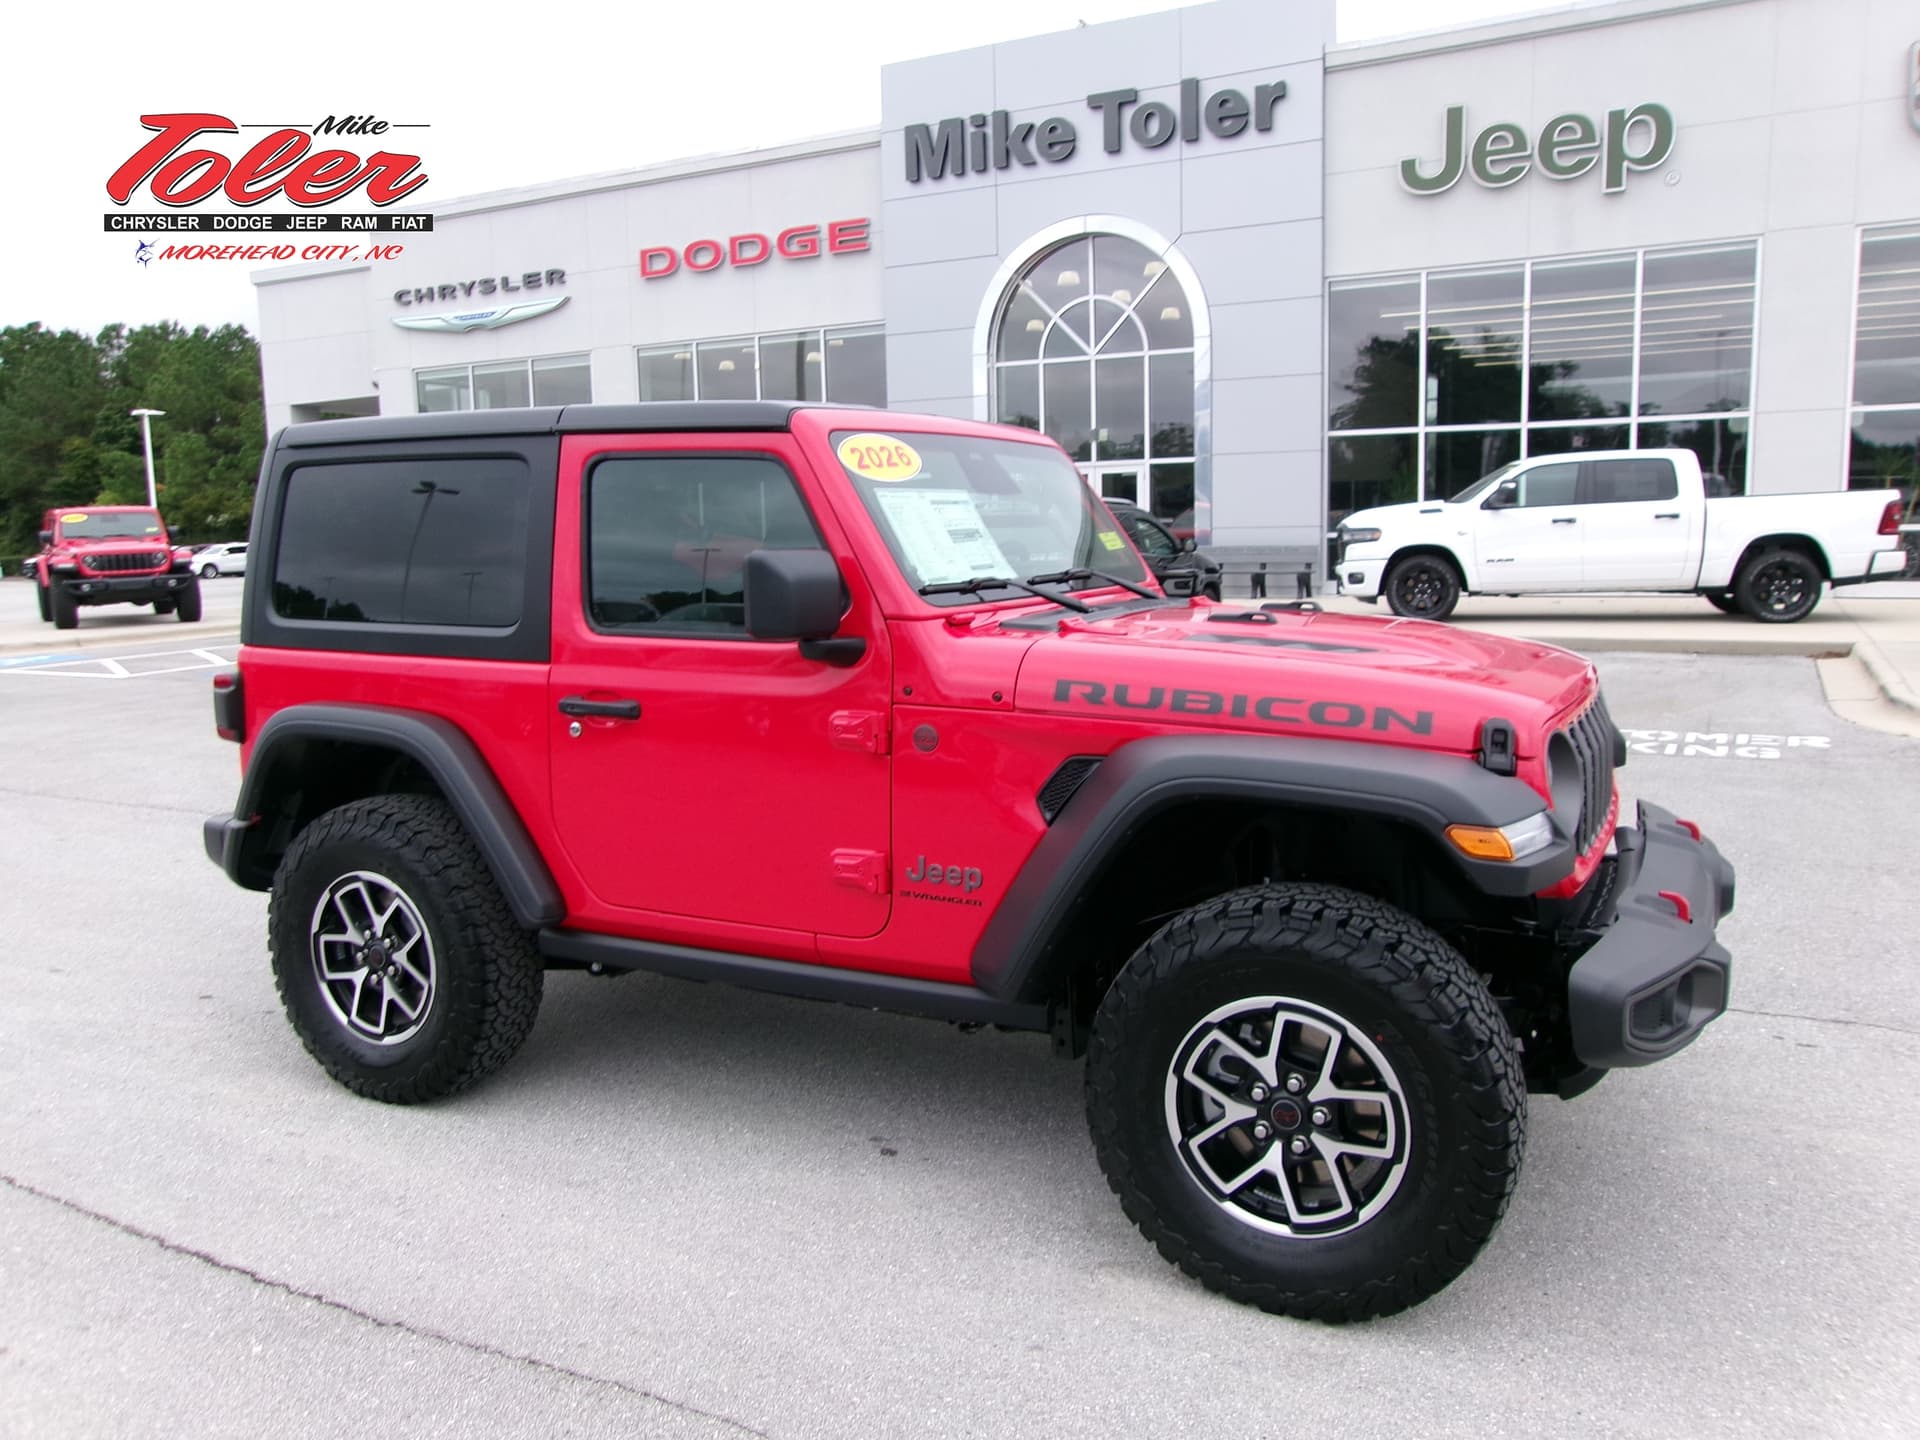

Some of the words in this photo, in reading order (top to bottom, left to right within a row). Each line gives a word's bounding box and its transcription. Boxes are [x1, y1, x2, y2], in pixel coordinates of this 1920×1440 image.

[904, 108, 1077, 183] Mike
[1087, 77, 1288, 154] Toler
[1400, 101, 1677, 194] Jeep
[640, 217, 871, 280] DODGE
[393, 268, 568, 307] CHRYSLER
[850, 446, 912, 470] 2026
[1053, 679, 1433, 736] RUBICON
[906, 854, 983, 894] Jeep
